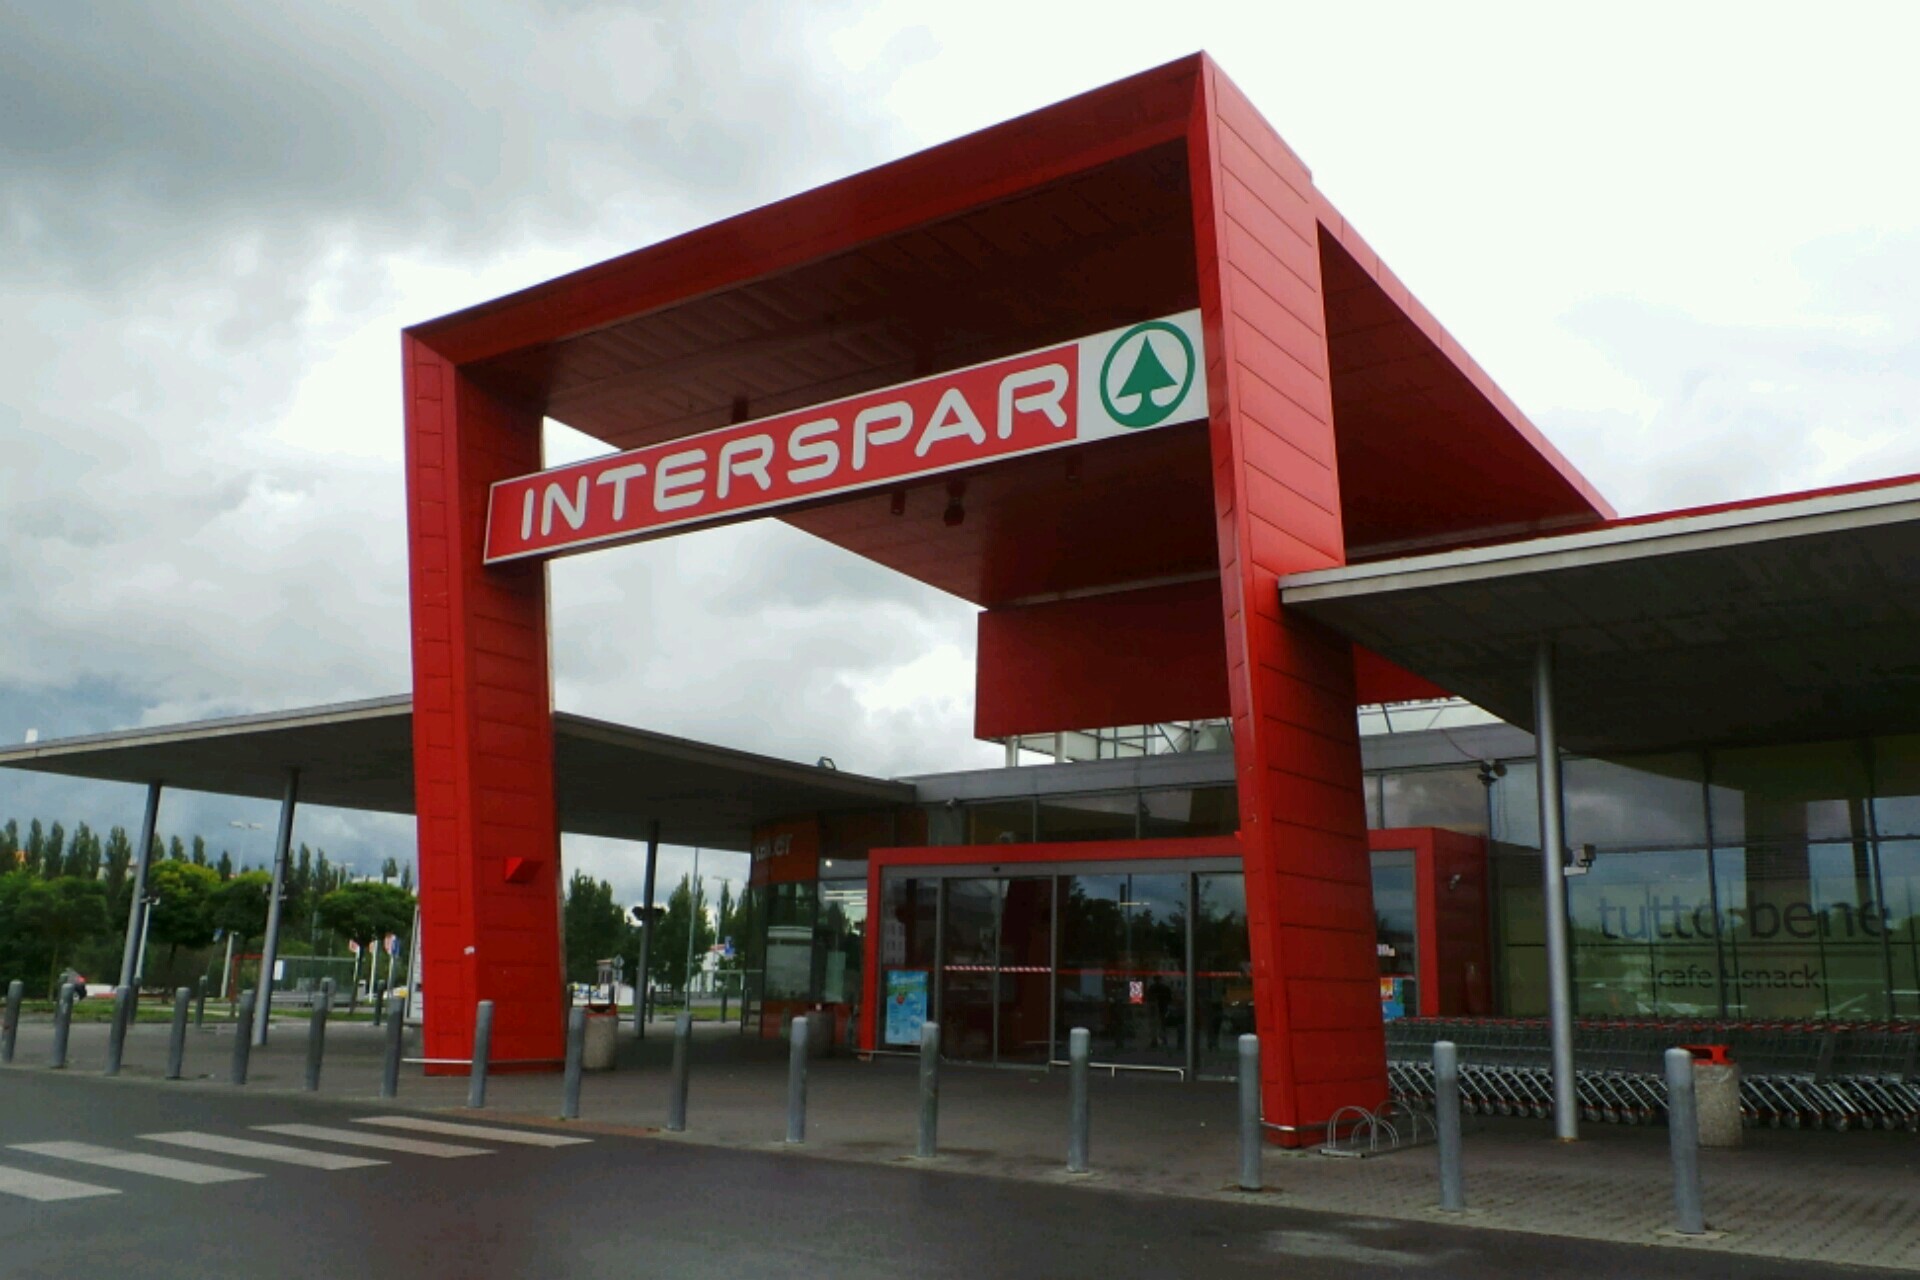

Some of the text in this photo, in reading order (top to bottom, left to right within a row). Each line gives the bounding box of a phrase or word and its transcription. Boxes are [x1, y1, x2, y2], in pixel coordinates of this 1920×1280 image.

[520, 363, 1070, 541] INTERSPAR
[1597, 889, 1892, 939] tutto bene
[1658, 964, 1713, 989] cafe
[1741, 963, 1821, 989] snack
